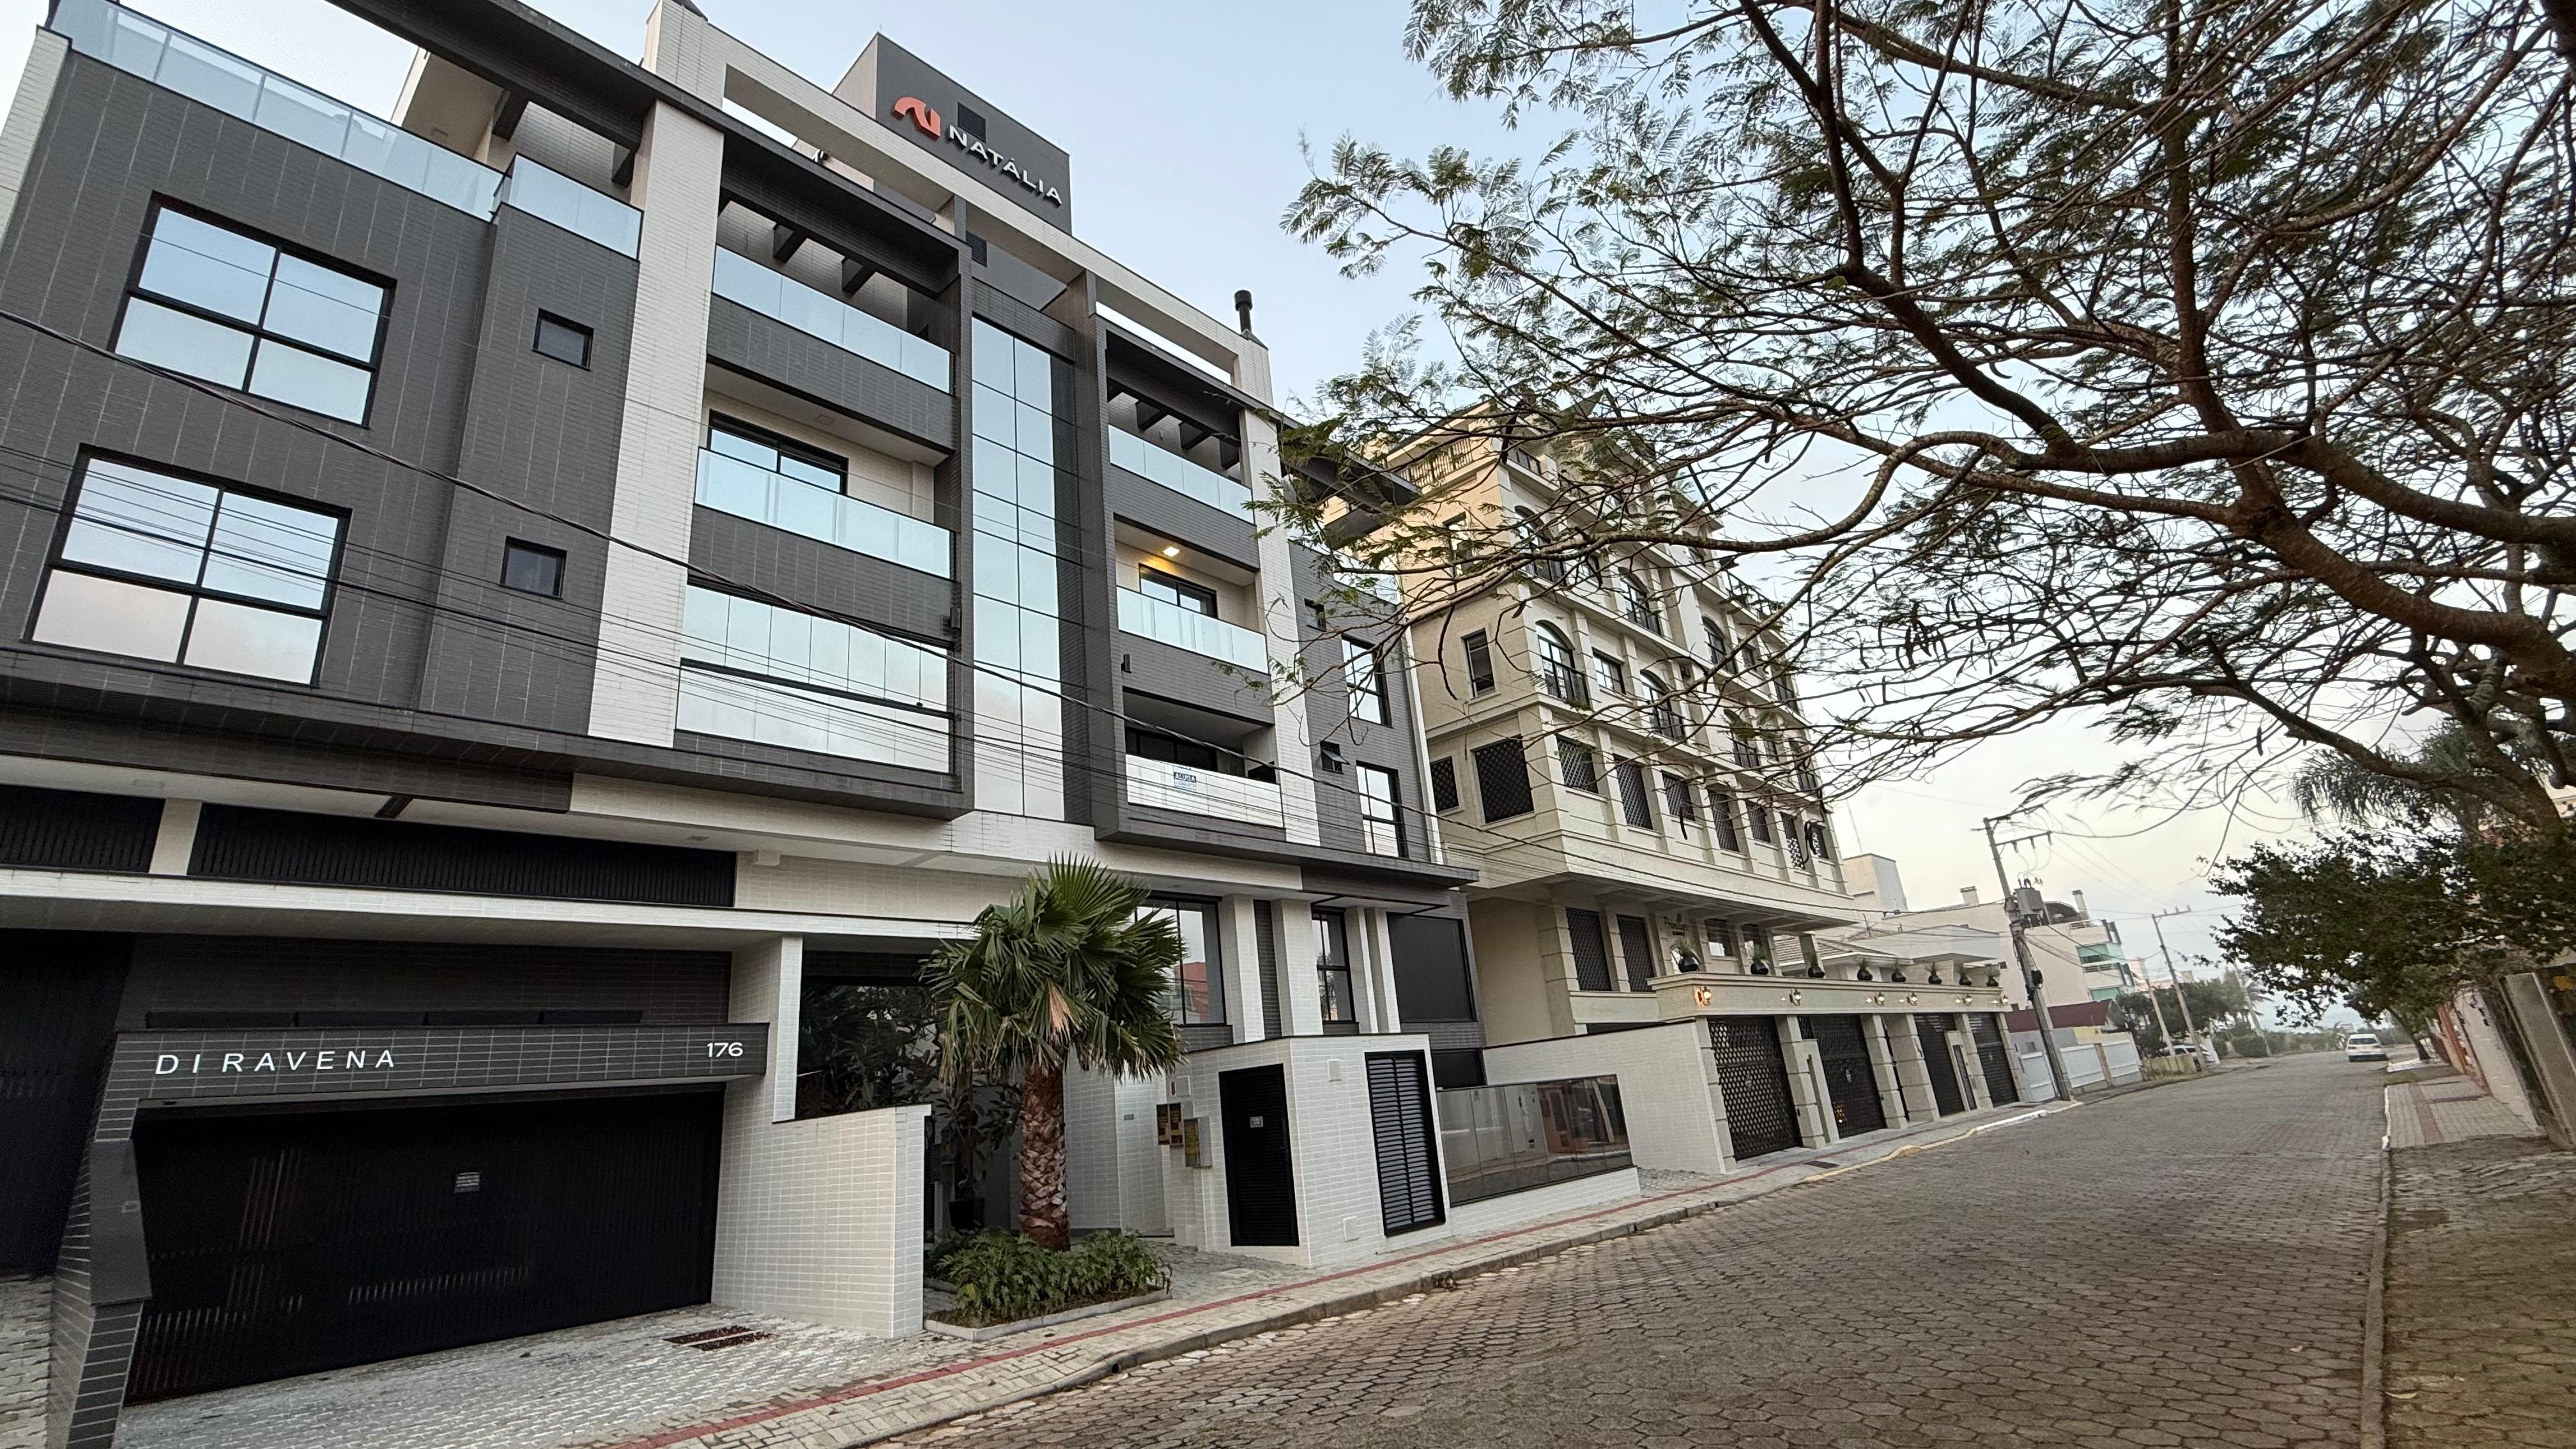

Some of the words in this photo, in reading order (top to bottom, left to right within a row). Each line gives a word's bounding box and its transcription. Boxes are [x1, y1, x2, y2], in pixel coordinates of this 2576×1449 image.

[949, 125, 1062, 205] NATÁLIA
[155, 1054, 201, 1075] DI
[222, 1050, 395, 1073] RAVENA
[707, 1042, 744, 1058] 176
